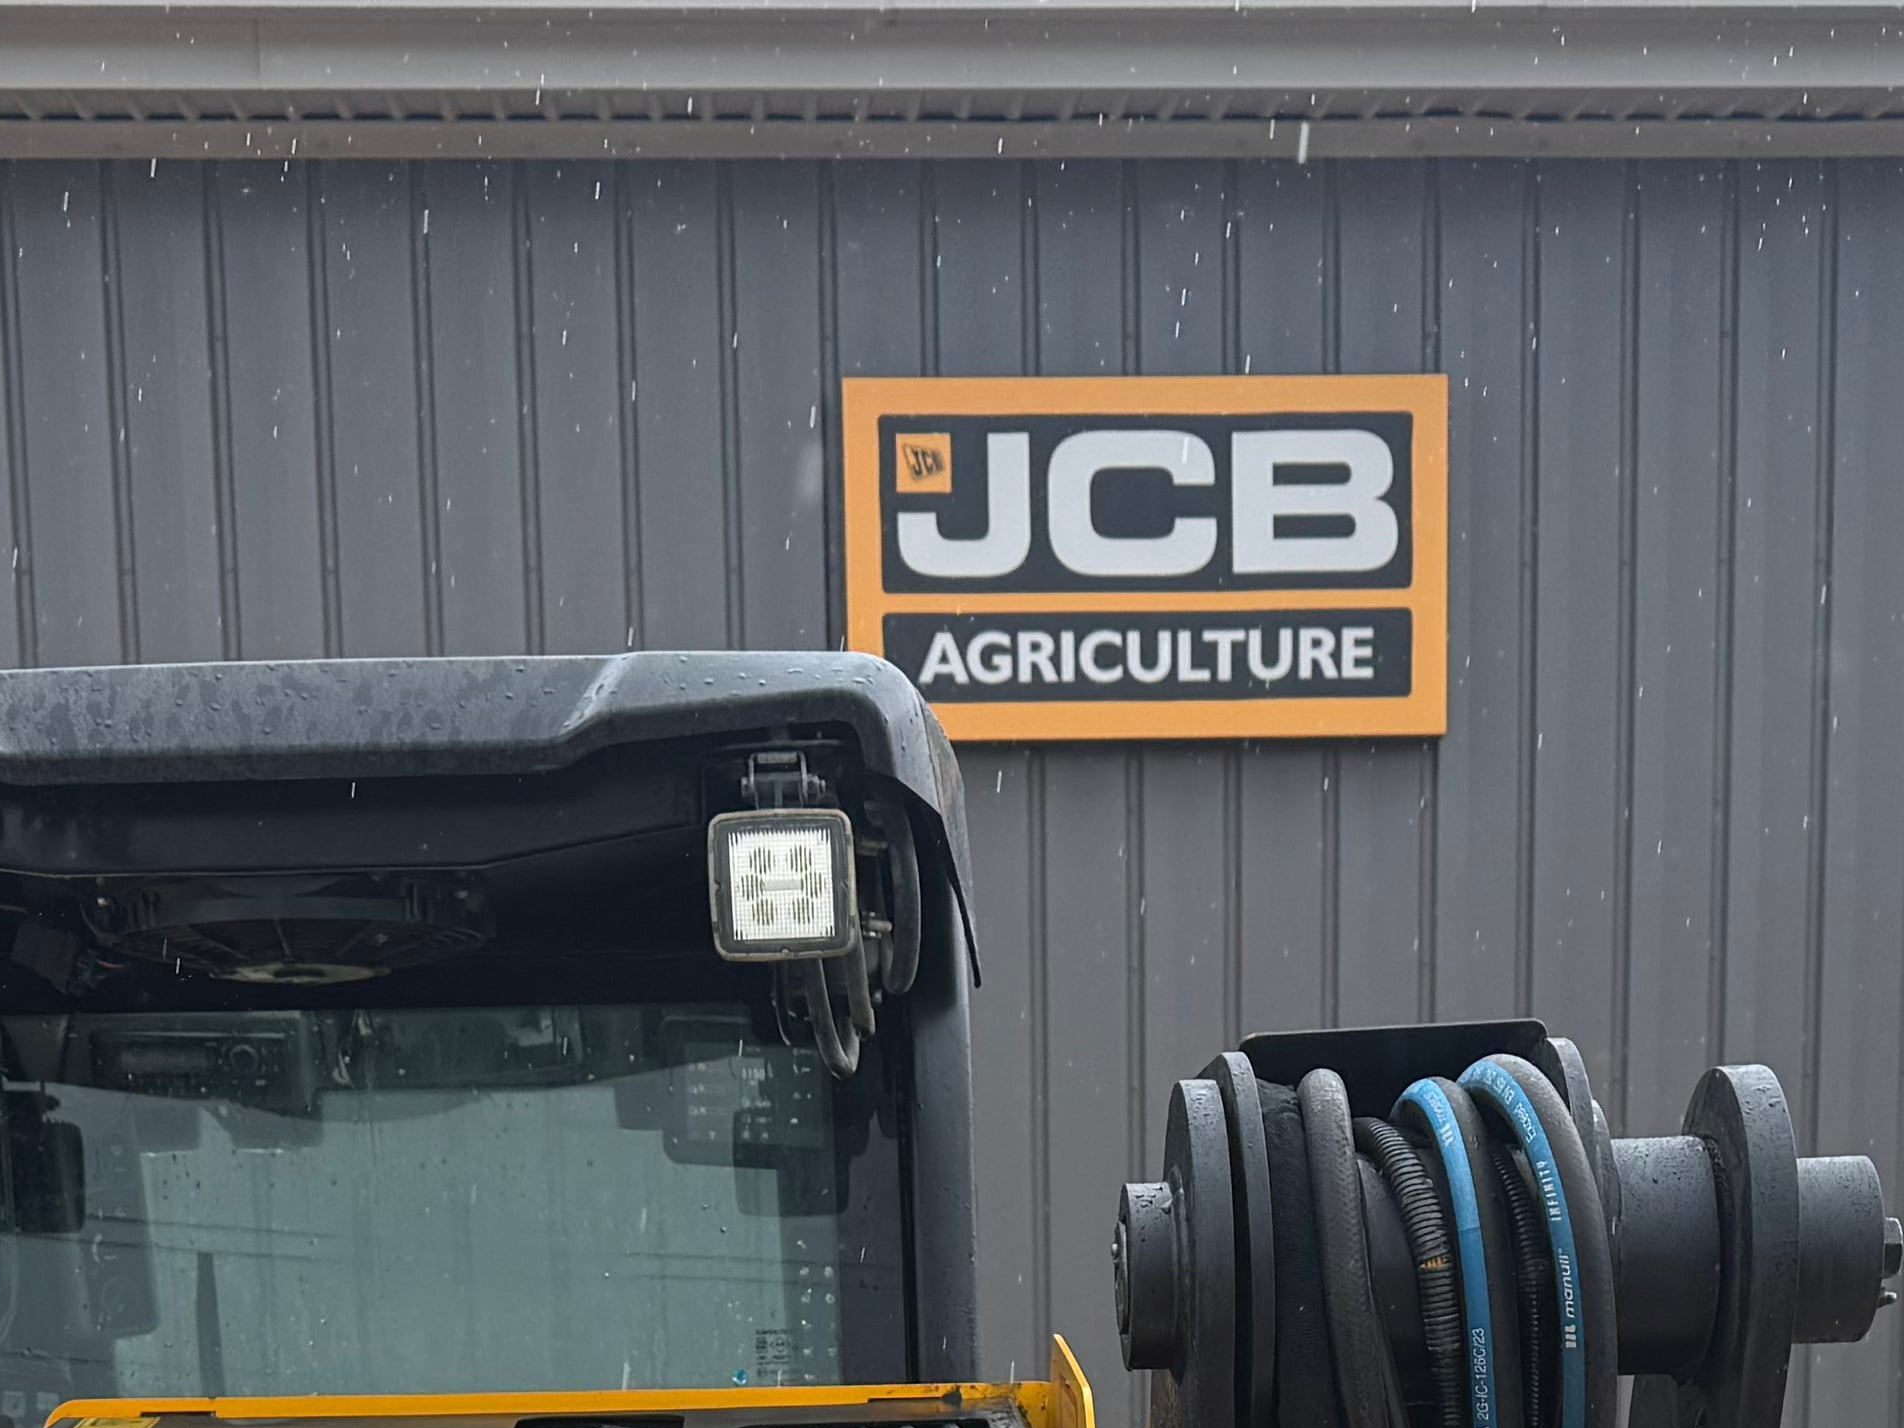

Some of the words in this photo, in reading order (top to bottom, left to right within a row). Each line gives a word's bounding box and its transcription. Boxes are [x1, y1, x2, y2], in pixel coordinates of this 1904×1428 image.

[896, 428, 1399, 577] JCB
[918, 626, 1374, 685] AGRICULTURE
[1537, 1160, 1562, 1222] INFINITY
